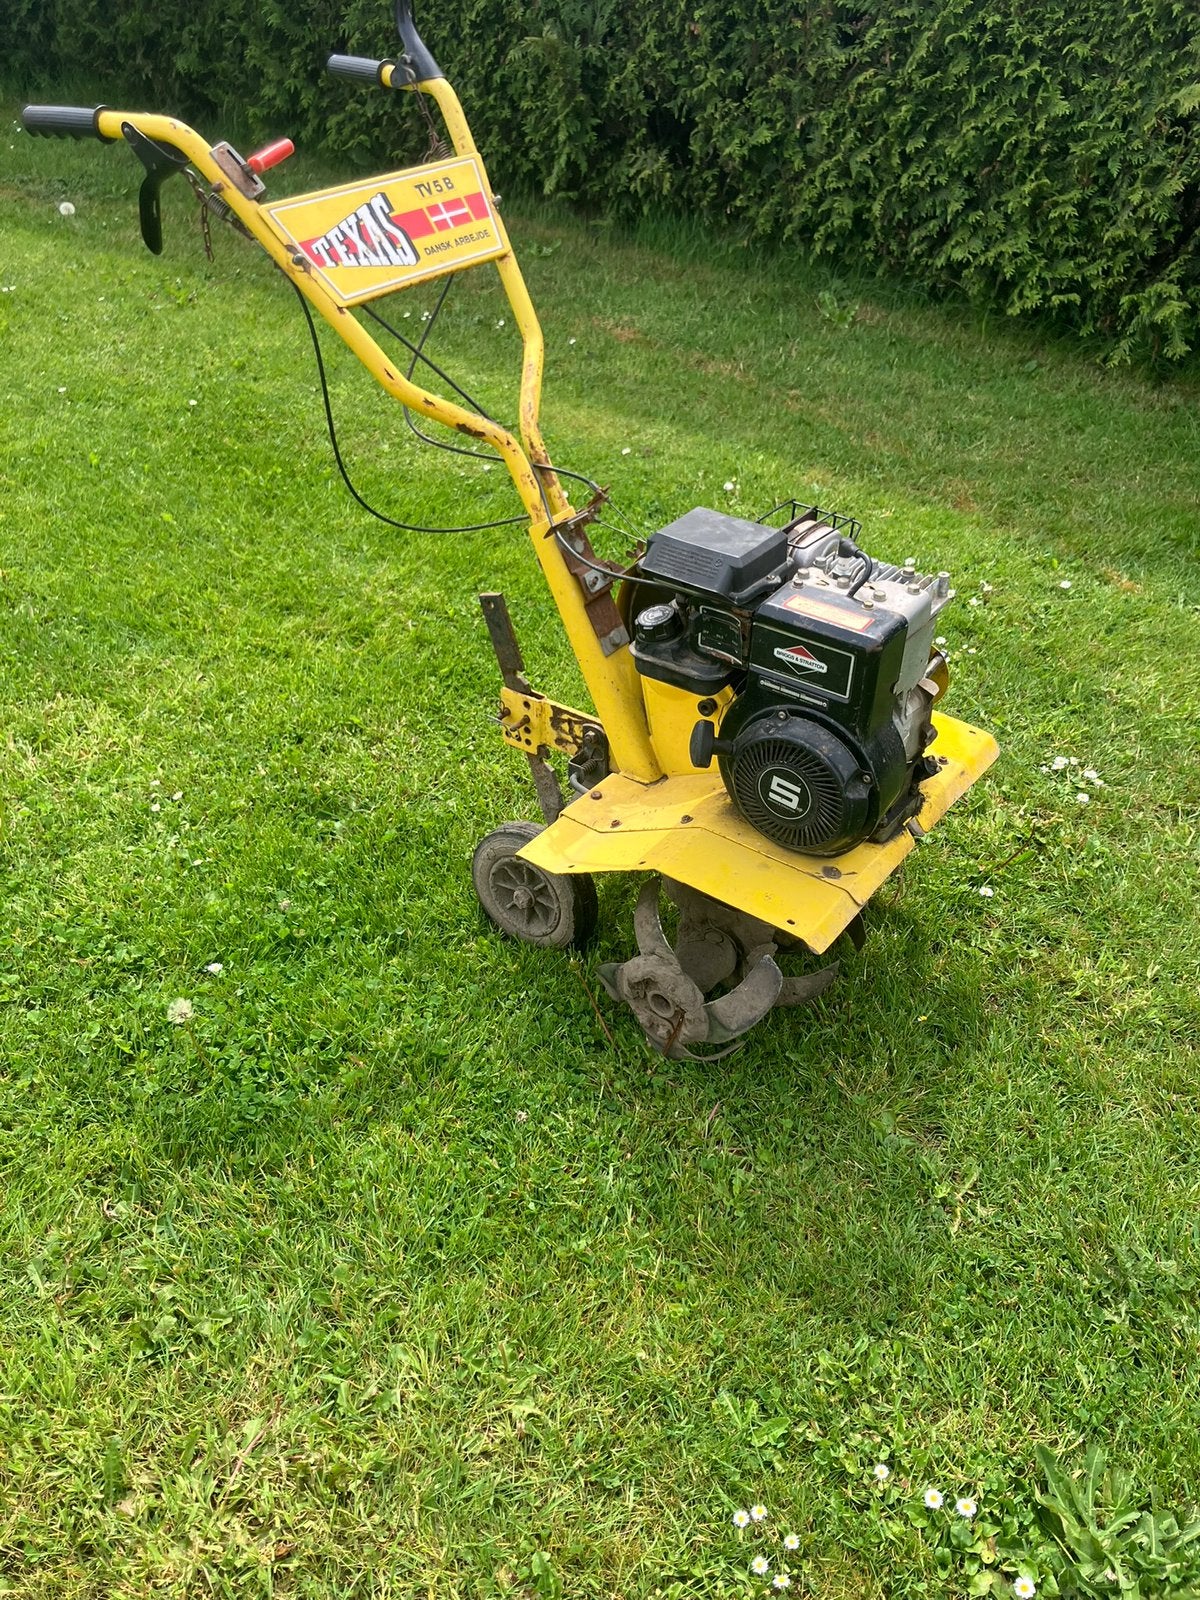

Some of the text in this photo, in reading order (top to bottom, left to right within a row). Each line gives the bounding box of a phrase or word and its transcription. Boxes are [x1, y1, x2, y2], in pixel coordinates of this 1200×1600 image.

[414, 176, 455, 197] TV 5 B
[311, 192, 420, 268] TEXAS
[424, 230, 490, 255] DANSK ARBEJDE
[776, 650, 795, 661] BRIGGS
[799, 659, 825, 671] STRATTON
